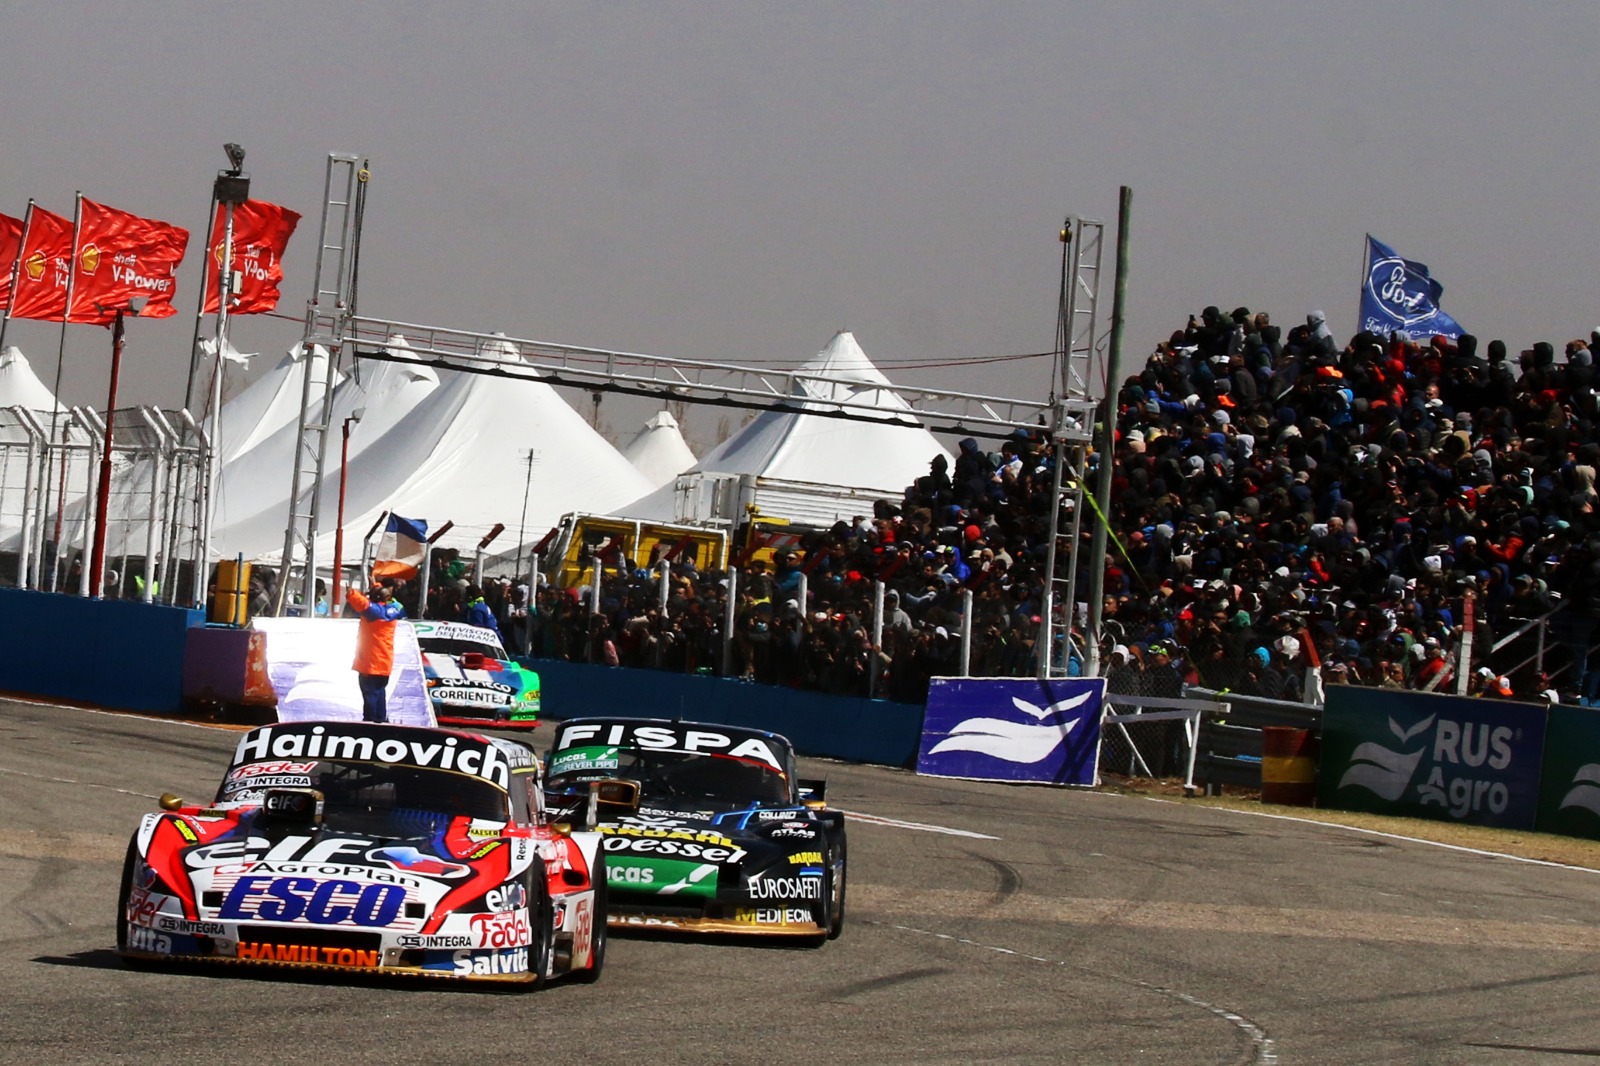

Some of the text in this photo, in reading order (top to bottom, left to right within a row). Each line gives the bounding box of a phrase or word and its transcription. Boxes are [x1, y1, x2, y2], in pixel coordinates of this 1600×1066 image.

[112, 264, 171, 292] V-Power
[438, 626, 496, 640] PREVISORA
[431, 689, 505, 705] CORRIENTES
[558, 725, 784, 772] FISPA
[1433, 719, 1513, 770] RUS
[233, 726, 509, 789] Haimovich
[553, 753, 587, 766] Lucas
[253, 776, 309, 786] INTEGRA
[1417, 766, 1509, 818] Agro
[595, 826, 743, 851] ARDAHL
[747, 877, 822, 899] EUROSAFETY
[218, 876, 407, 928] ESCO
[179, 921, 226, 935] INTEGRA
[426, 935, 472, 947] INTEGRA
[237, 941, 379, 968] HAMILTON
